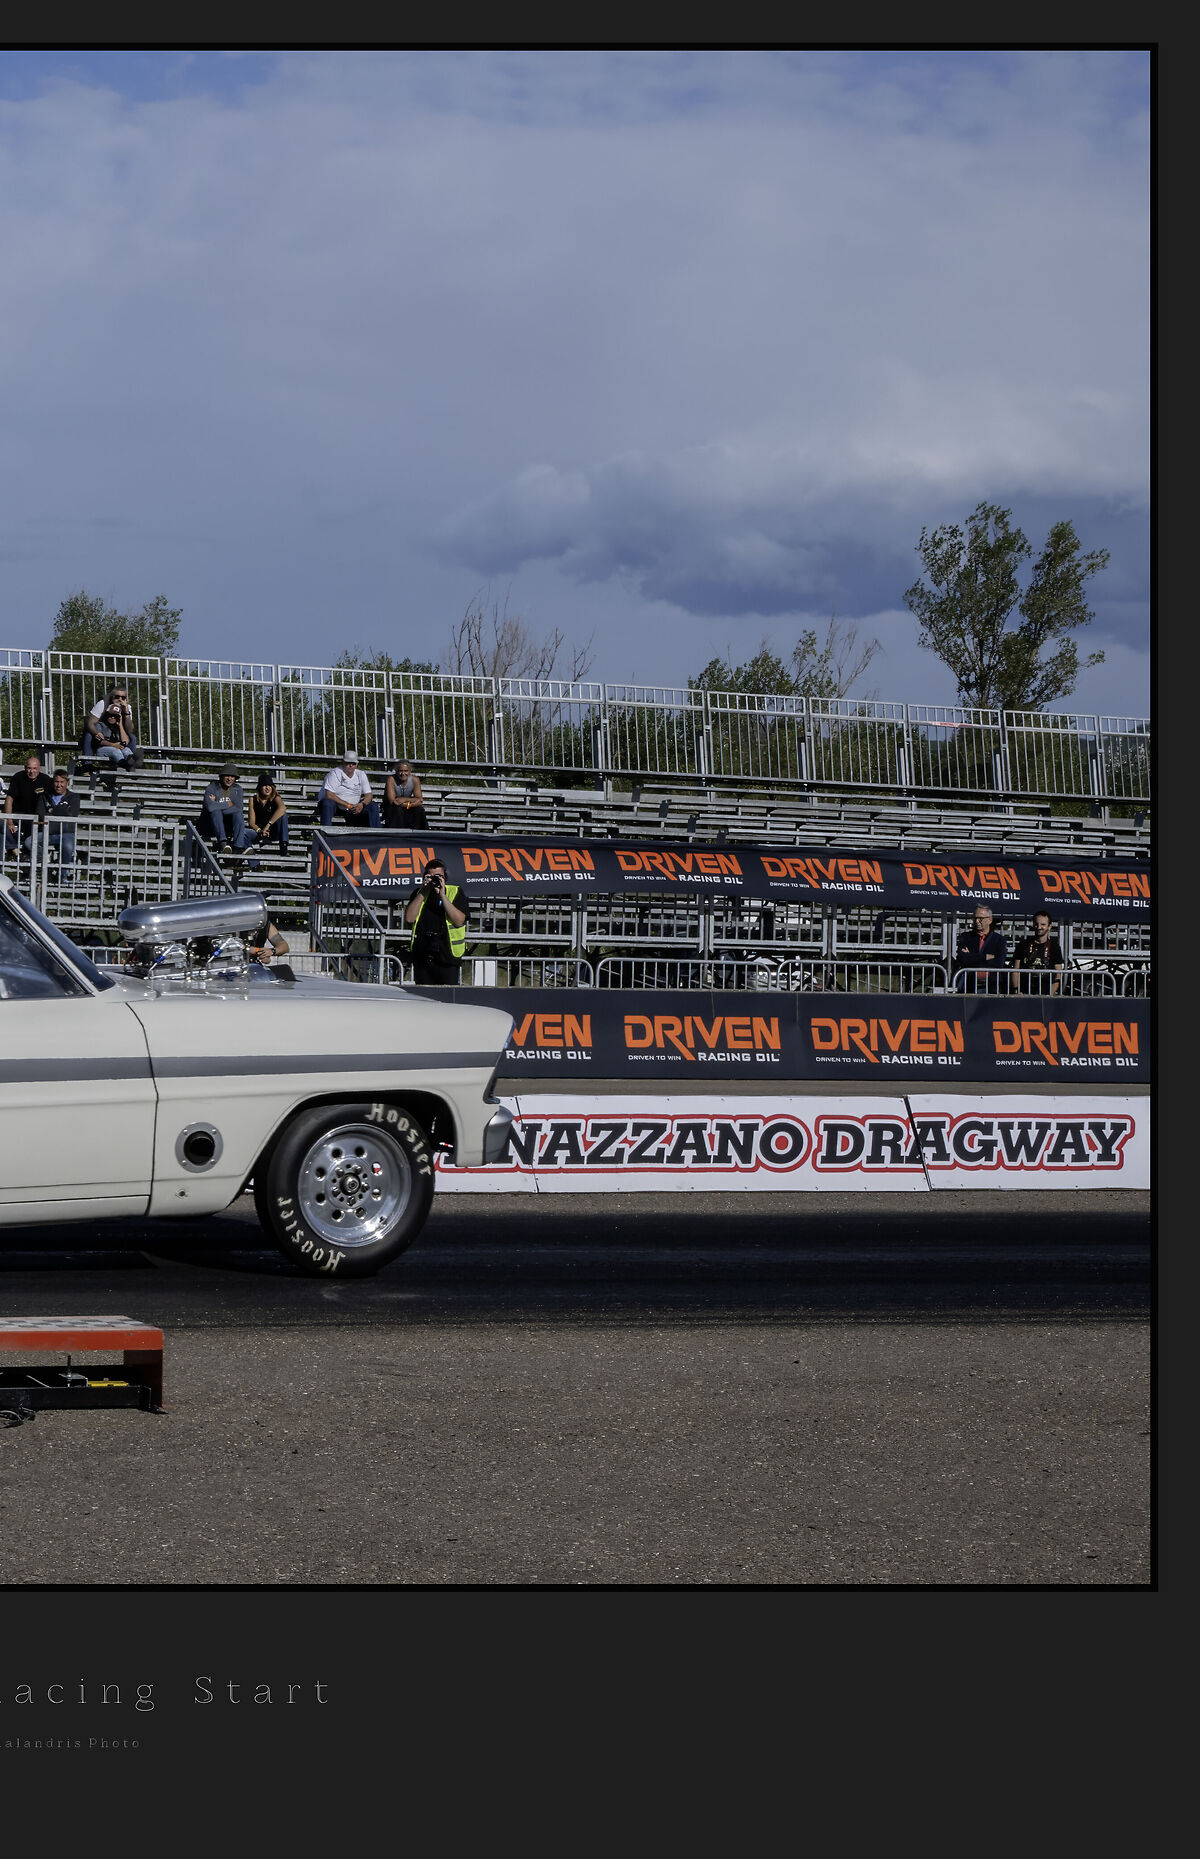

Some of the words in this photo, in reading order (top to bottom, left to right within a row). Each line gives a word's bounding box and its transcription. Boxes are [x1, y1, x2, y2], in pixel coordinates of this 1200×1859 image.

[461, 847, 595, 881] DRIVEN
[524, 872, 572, 882] RACING
[573, 872, 596, 880] OIL
[614, 850, 743, 881] DRIVEN
[678, 874, 721, 884] RACING
[723, 876, 744, 886] OIL
[759, 856, 884, 889] DRIVEN
[903, 862, 1021, 897] DRIVEN
[362, 877, 411, 887] RACING
[821, 882, 863, 892] RACING
[865, 884, 885, 893] OIL
[960, 889, 1000, 900] RACING
[1001, 891, 1020, 900] OIL
[1037, 869, 1150, 905] DRIVEN
[1092, 897, 1130, 908] RACING
[1132, 899, 1150, 908] OIL
[512, 1013, 593, 1048] VEN
[623, 1015, 782, 1061] DRIVEN
[810, 1017, 965, 1064] DRIVEN
[992, 1021, 1139, 1066] DRIVEN
[505, 1049, 562, 1060] RACING
[566, 1050, 592, 1060] OIL
[697, 1051, 751, 1062] RACING
[755, 1052, 780, 1062] OIL
[880, 1054, 934, 1065] RACING
[937, 1056, 961, 1065] OIL
[1060, 1056, 1112, 1067] RACING
[1115, 1057, 1138, 1067] OIL
[364, 1103, 432, 1176] Hoosier
[492, 1121, 804, 1166] NAZZANO
[819, 1118, 1128, 1167] DRAGWAY
[277, 1196, 347, 1273] Hoosier
